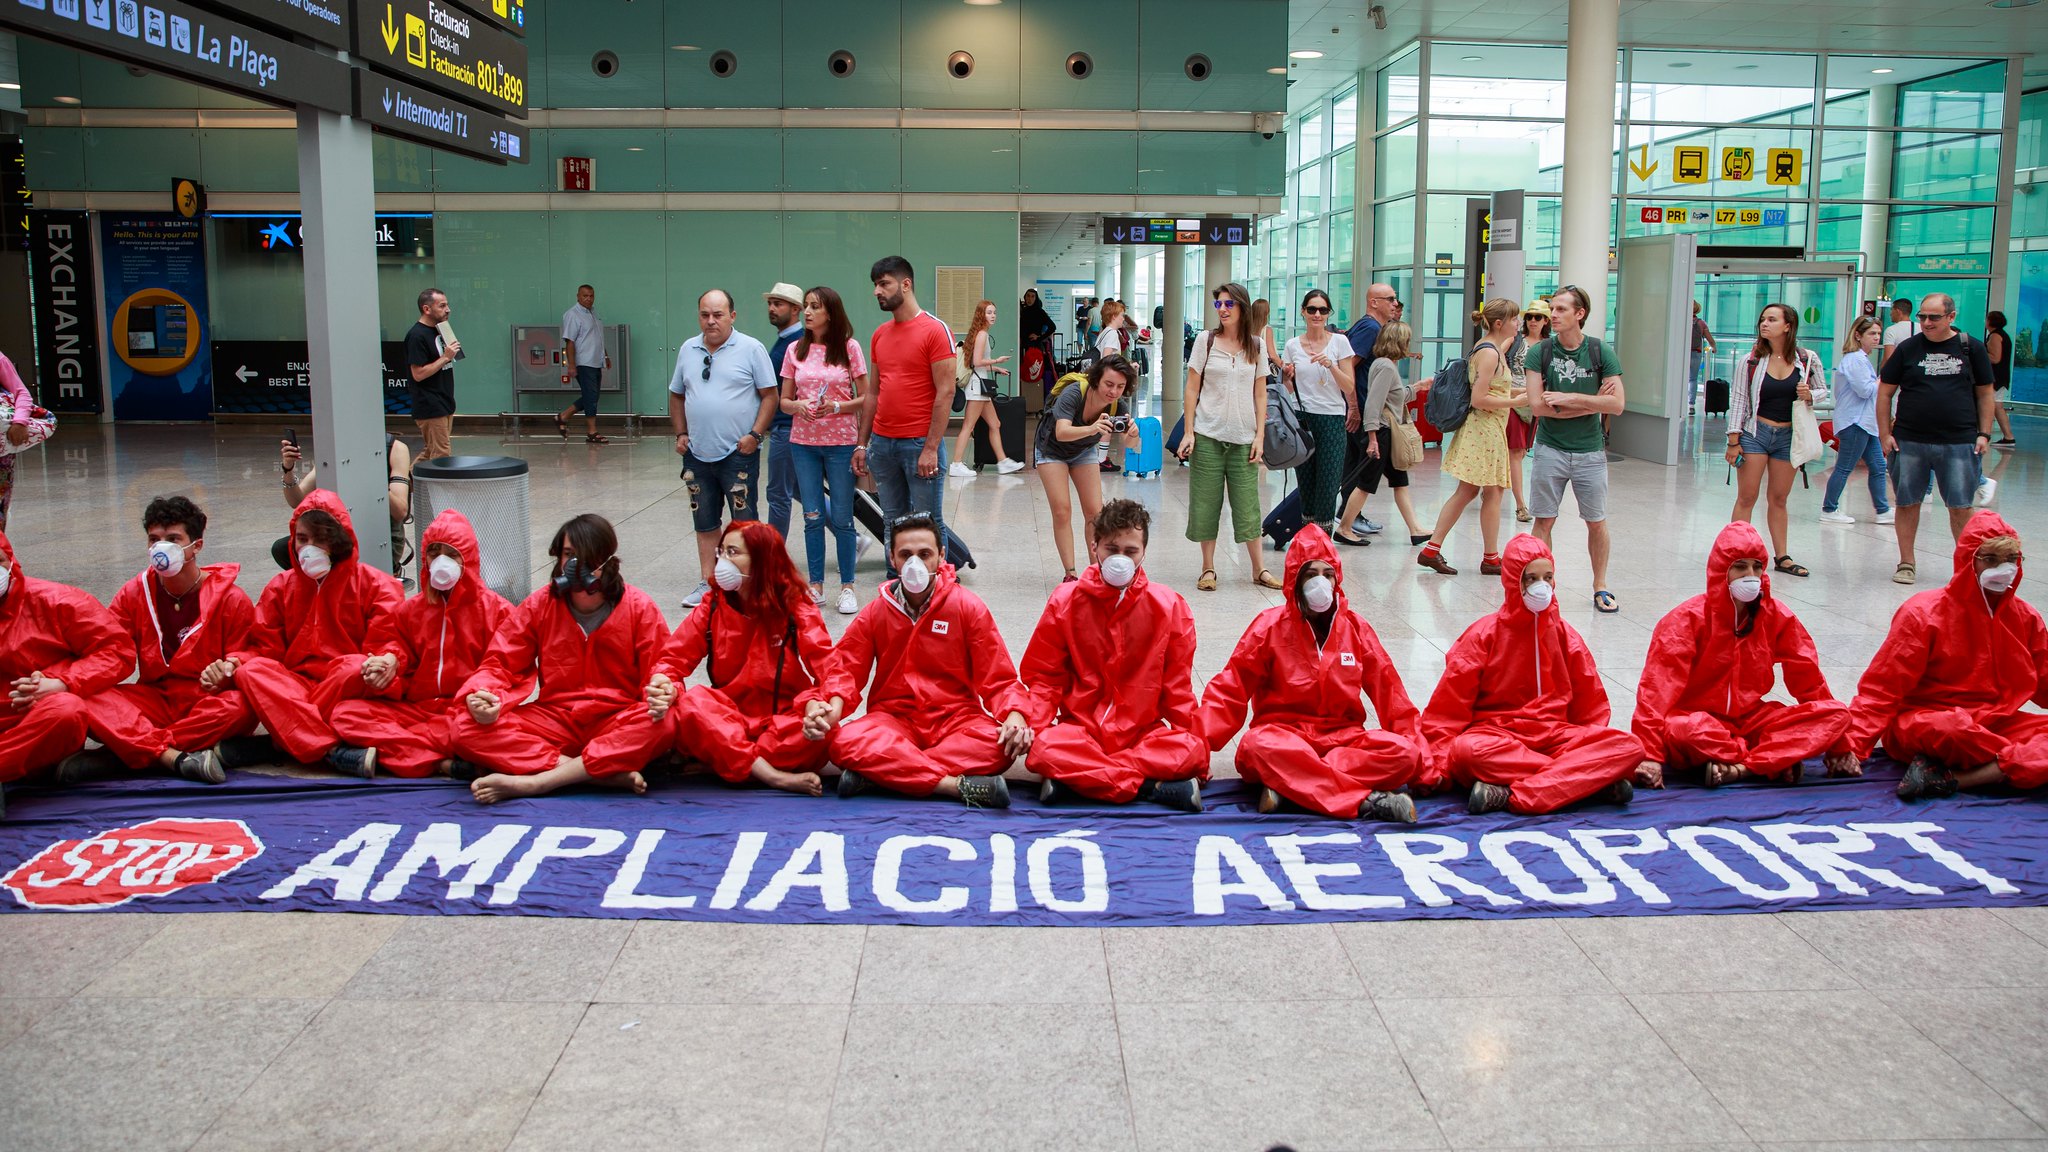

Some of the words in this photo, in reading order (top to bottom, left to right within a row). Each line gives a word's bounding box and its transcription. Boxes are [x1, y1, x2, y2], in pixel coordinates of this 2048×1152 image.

[303, 0, 341, 25] Operadores
[428, 1, 470, 39] Facturació
[511, 6, 516, 20] F
[518, 10, 523, 24] E
[197, 25, 221, 63] La
[228, 35, 278, 87] Plaça
[429, 27, 460, 56] Check-in
[430, 50, 475, 87] Facturación
[477, 60, 498, 96] 801
[503, 73, 523, 106] 899
[497, 61, 504, 76] to
[395, 91, 454, 134] Intermodal
[456, 112, 468, 138] T1
[1645, 210, 1659, 221] 46
[1667, 210, 1686, 221] PR1
[1717, 211, 1735, 222] L77
[1741, 212, 1759, 222] L99
[1766, 210, 1783, 220] N17
[47, 224, 84, 398] EXCHANGE
[287, 362, 310, 371] ENJO
[268, 377, 294, 387] BEST
[934, 623, 946, 631] 3M
[28, 838, 243, 888] STOP
[258, 822, 1108, 913] AMPLIACIÓ
[1193, 821, 2021, 914] AEROPORT
